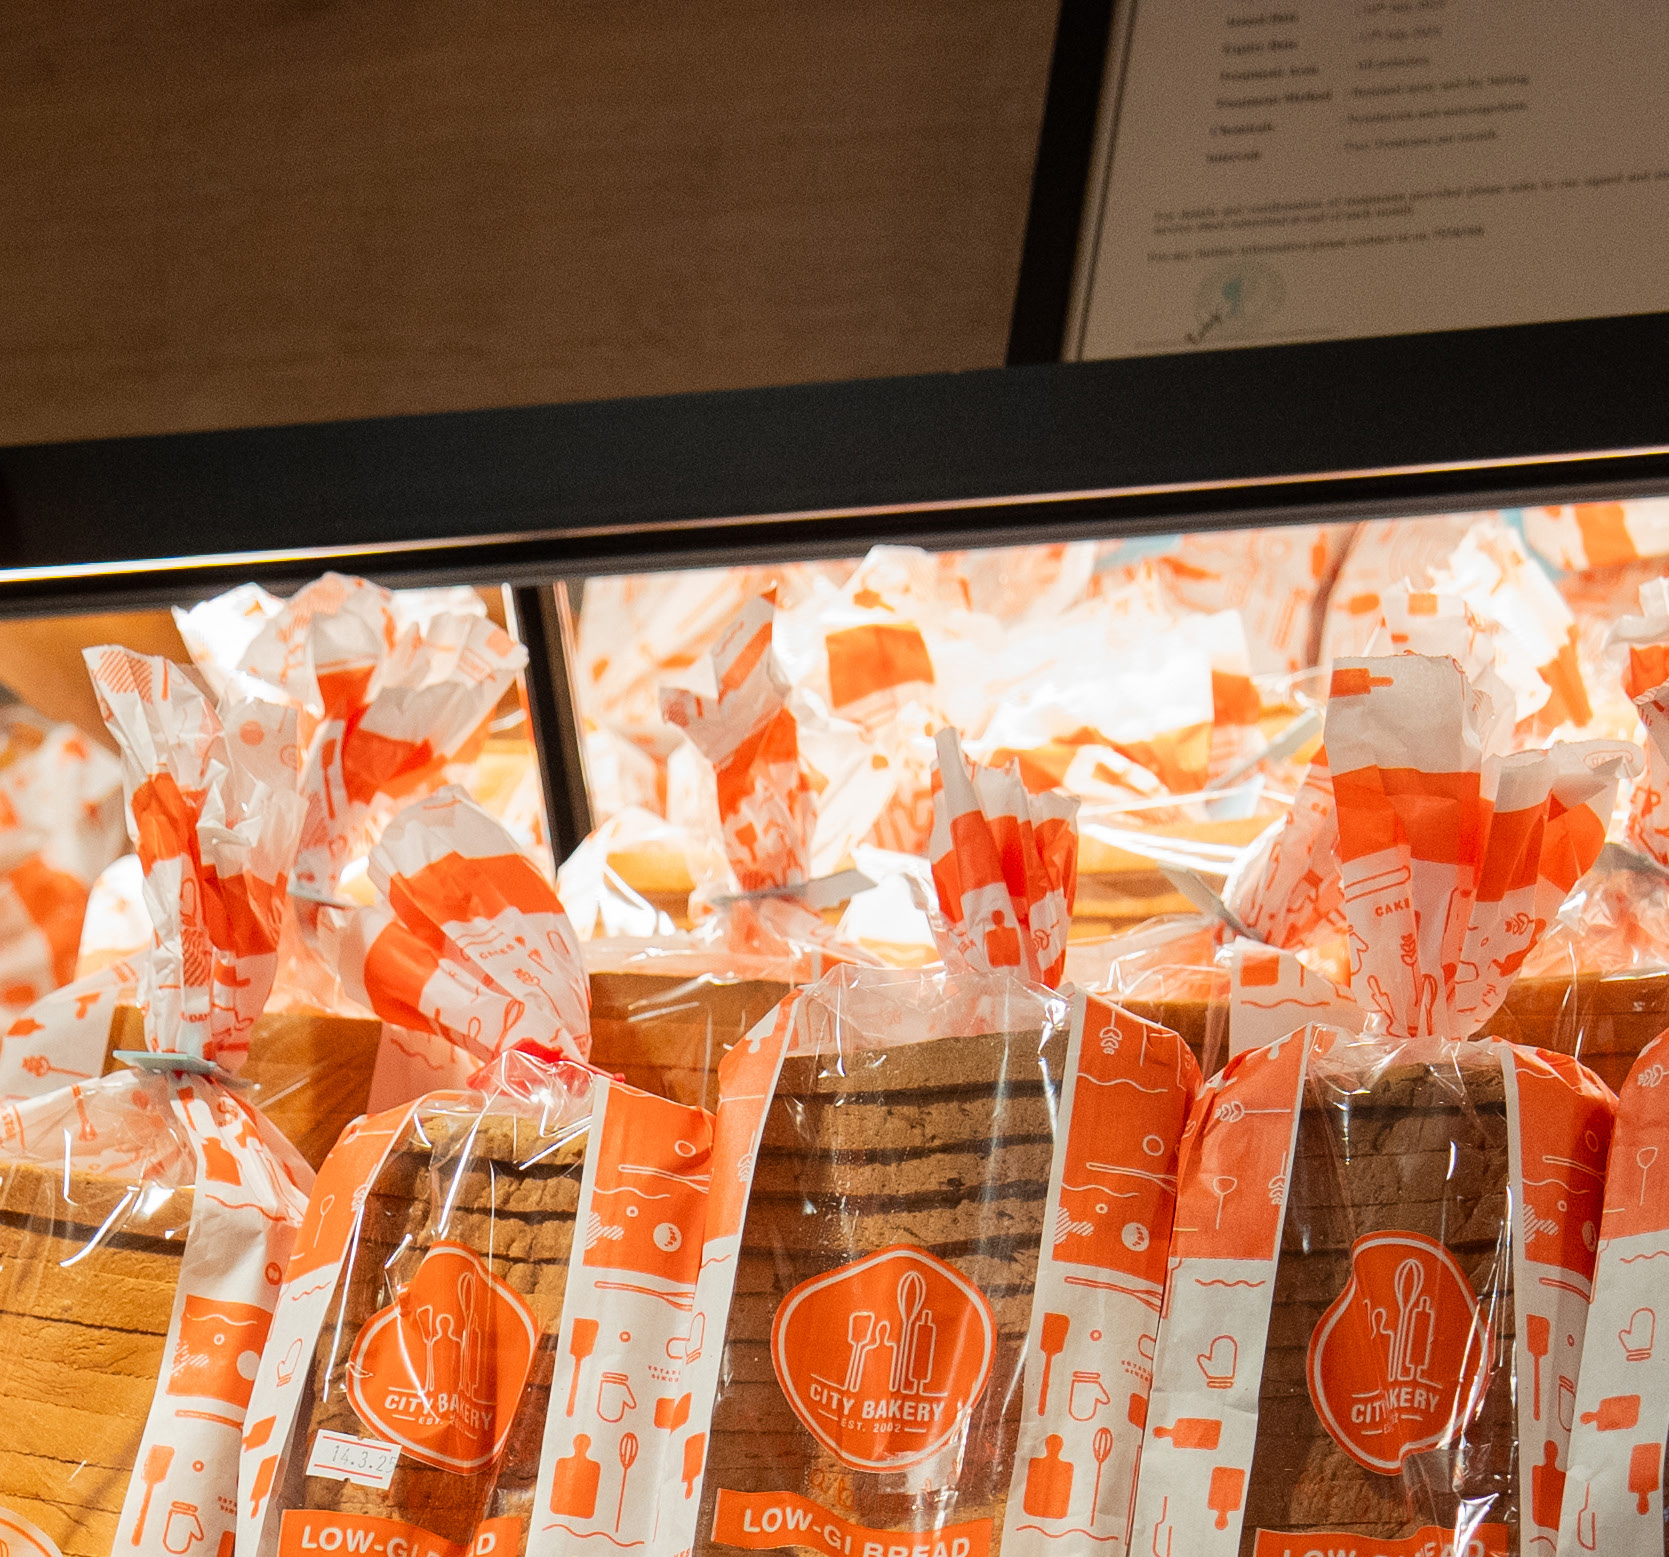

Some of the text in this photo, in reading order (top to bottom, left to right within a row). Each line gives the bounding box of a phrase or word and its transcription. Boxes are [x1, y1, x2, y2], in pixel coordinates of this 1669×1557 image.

[384, 1392, 434, 1416] CITY
[438, 1392, 494, 1431] BAKERY
[810, 1382, 945, 1423] CITY BAKERY
[1385, 1386, 1440, 1417] KERY
[840, 1418, 901, 1433] EST. 2002
[331, 1445, 398, 1475] 14.3.25
[743, 1507, 851, 1556] LOW-GI
